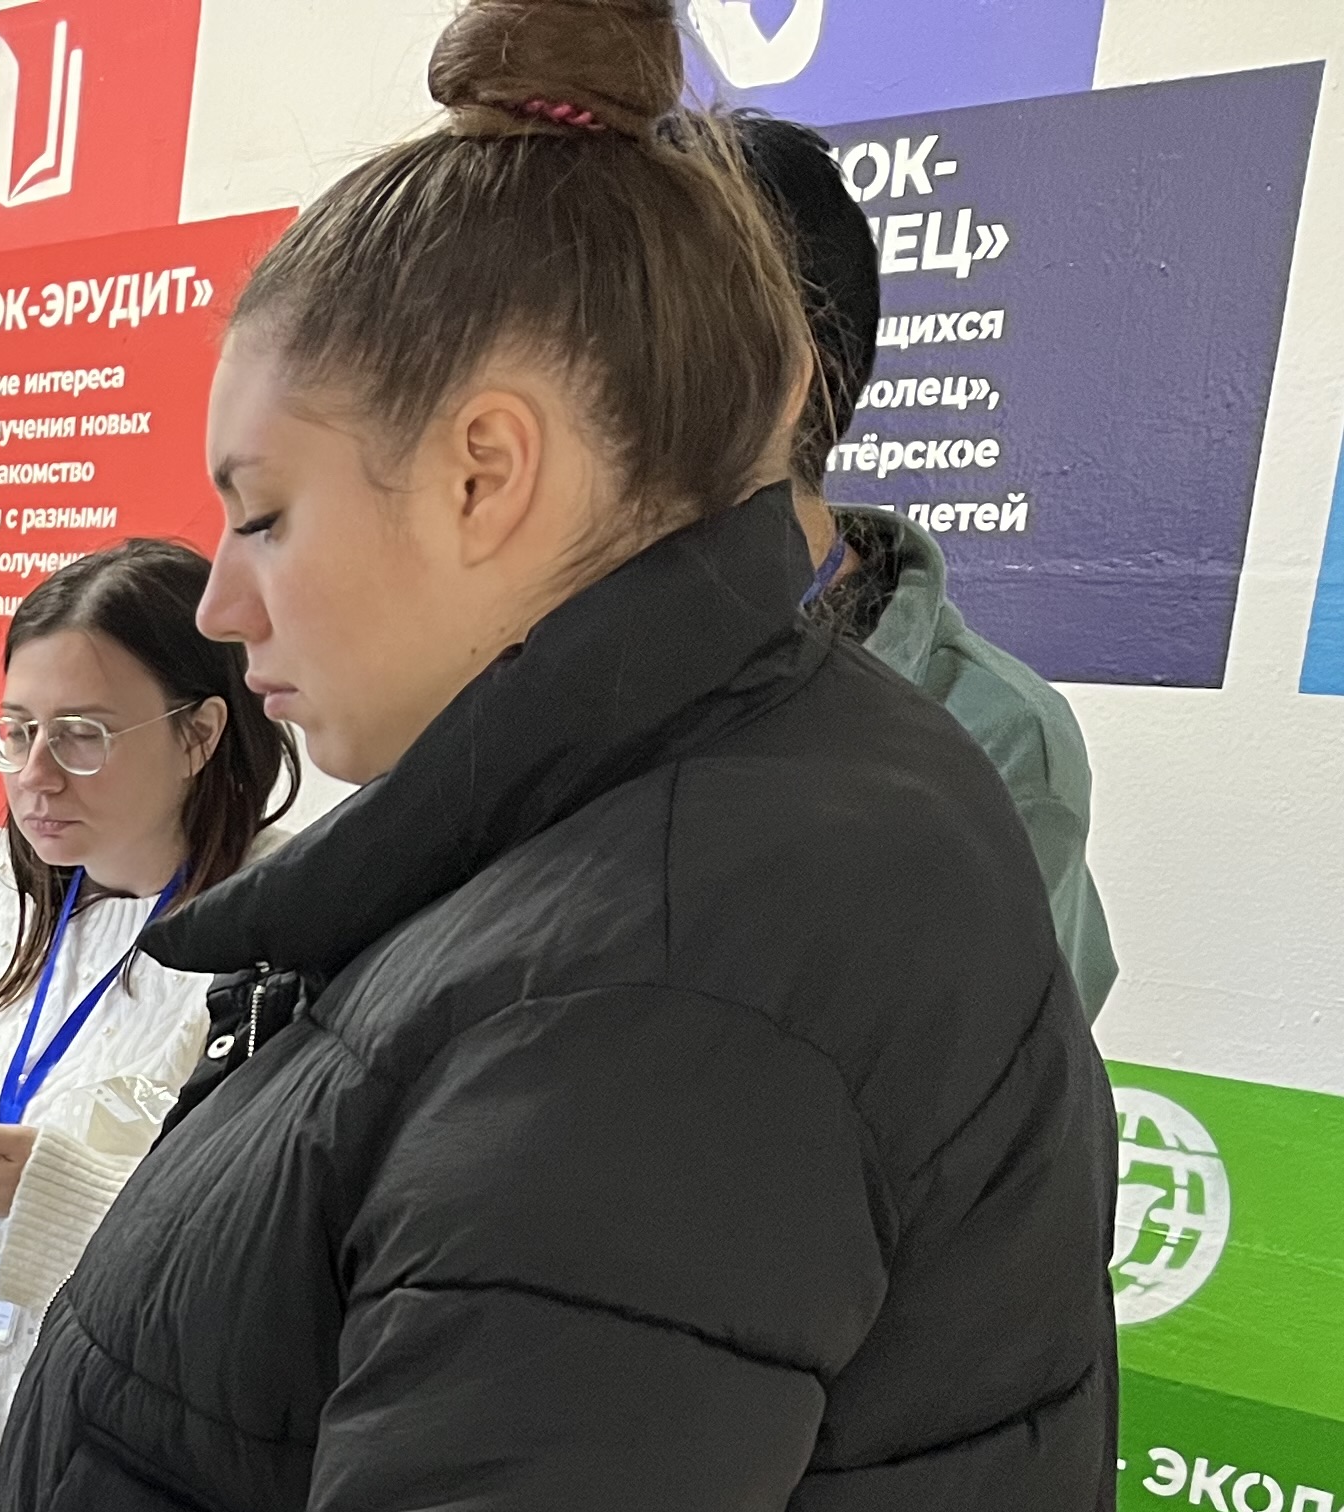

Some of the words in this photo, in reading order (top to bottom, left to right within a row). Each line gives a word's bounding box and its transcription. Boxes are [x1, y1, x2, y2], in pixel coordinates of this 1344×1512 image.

[827, 135, 957, 202] ОК-
[24, 365, 126, 397] интереса
[80, 411, 152, 436] новых
[5, 509, 18, 530] с
[21, 507, 118, 535] разными
